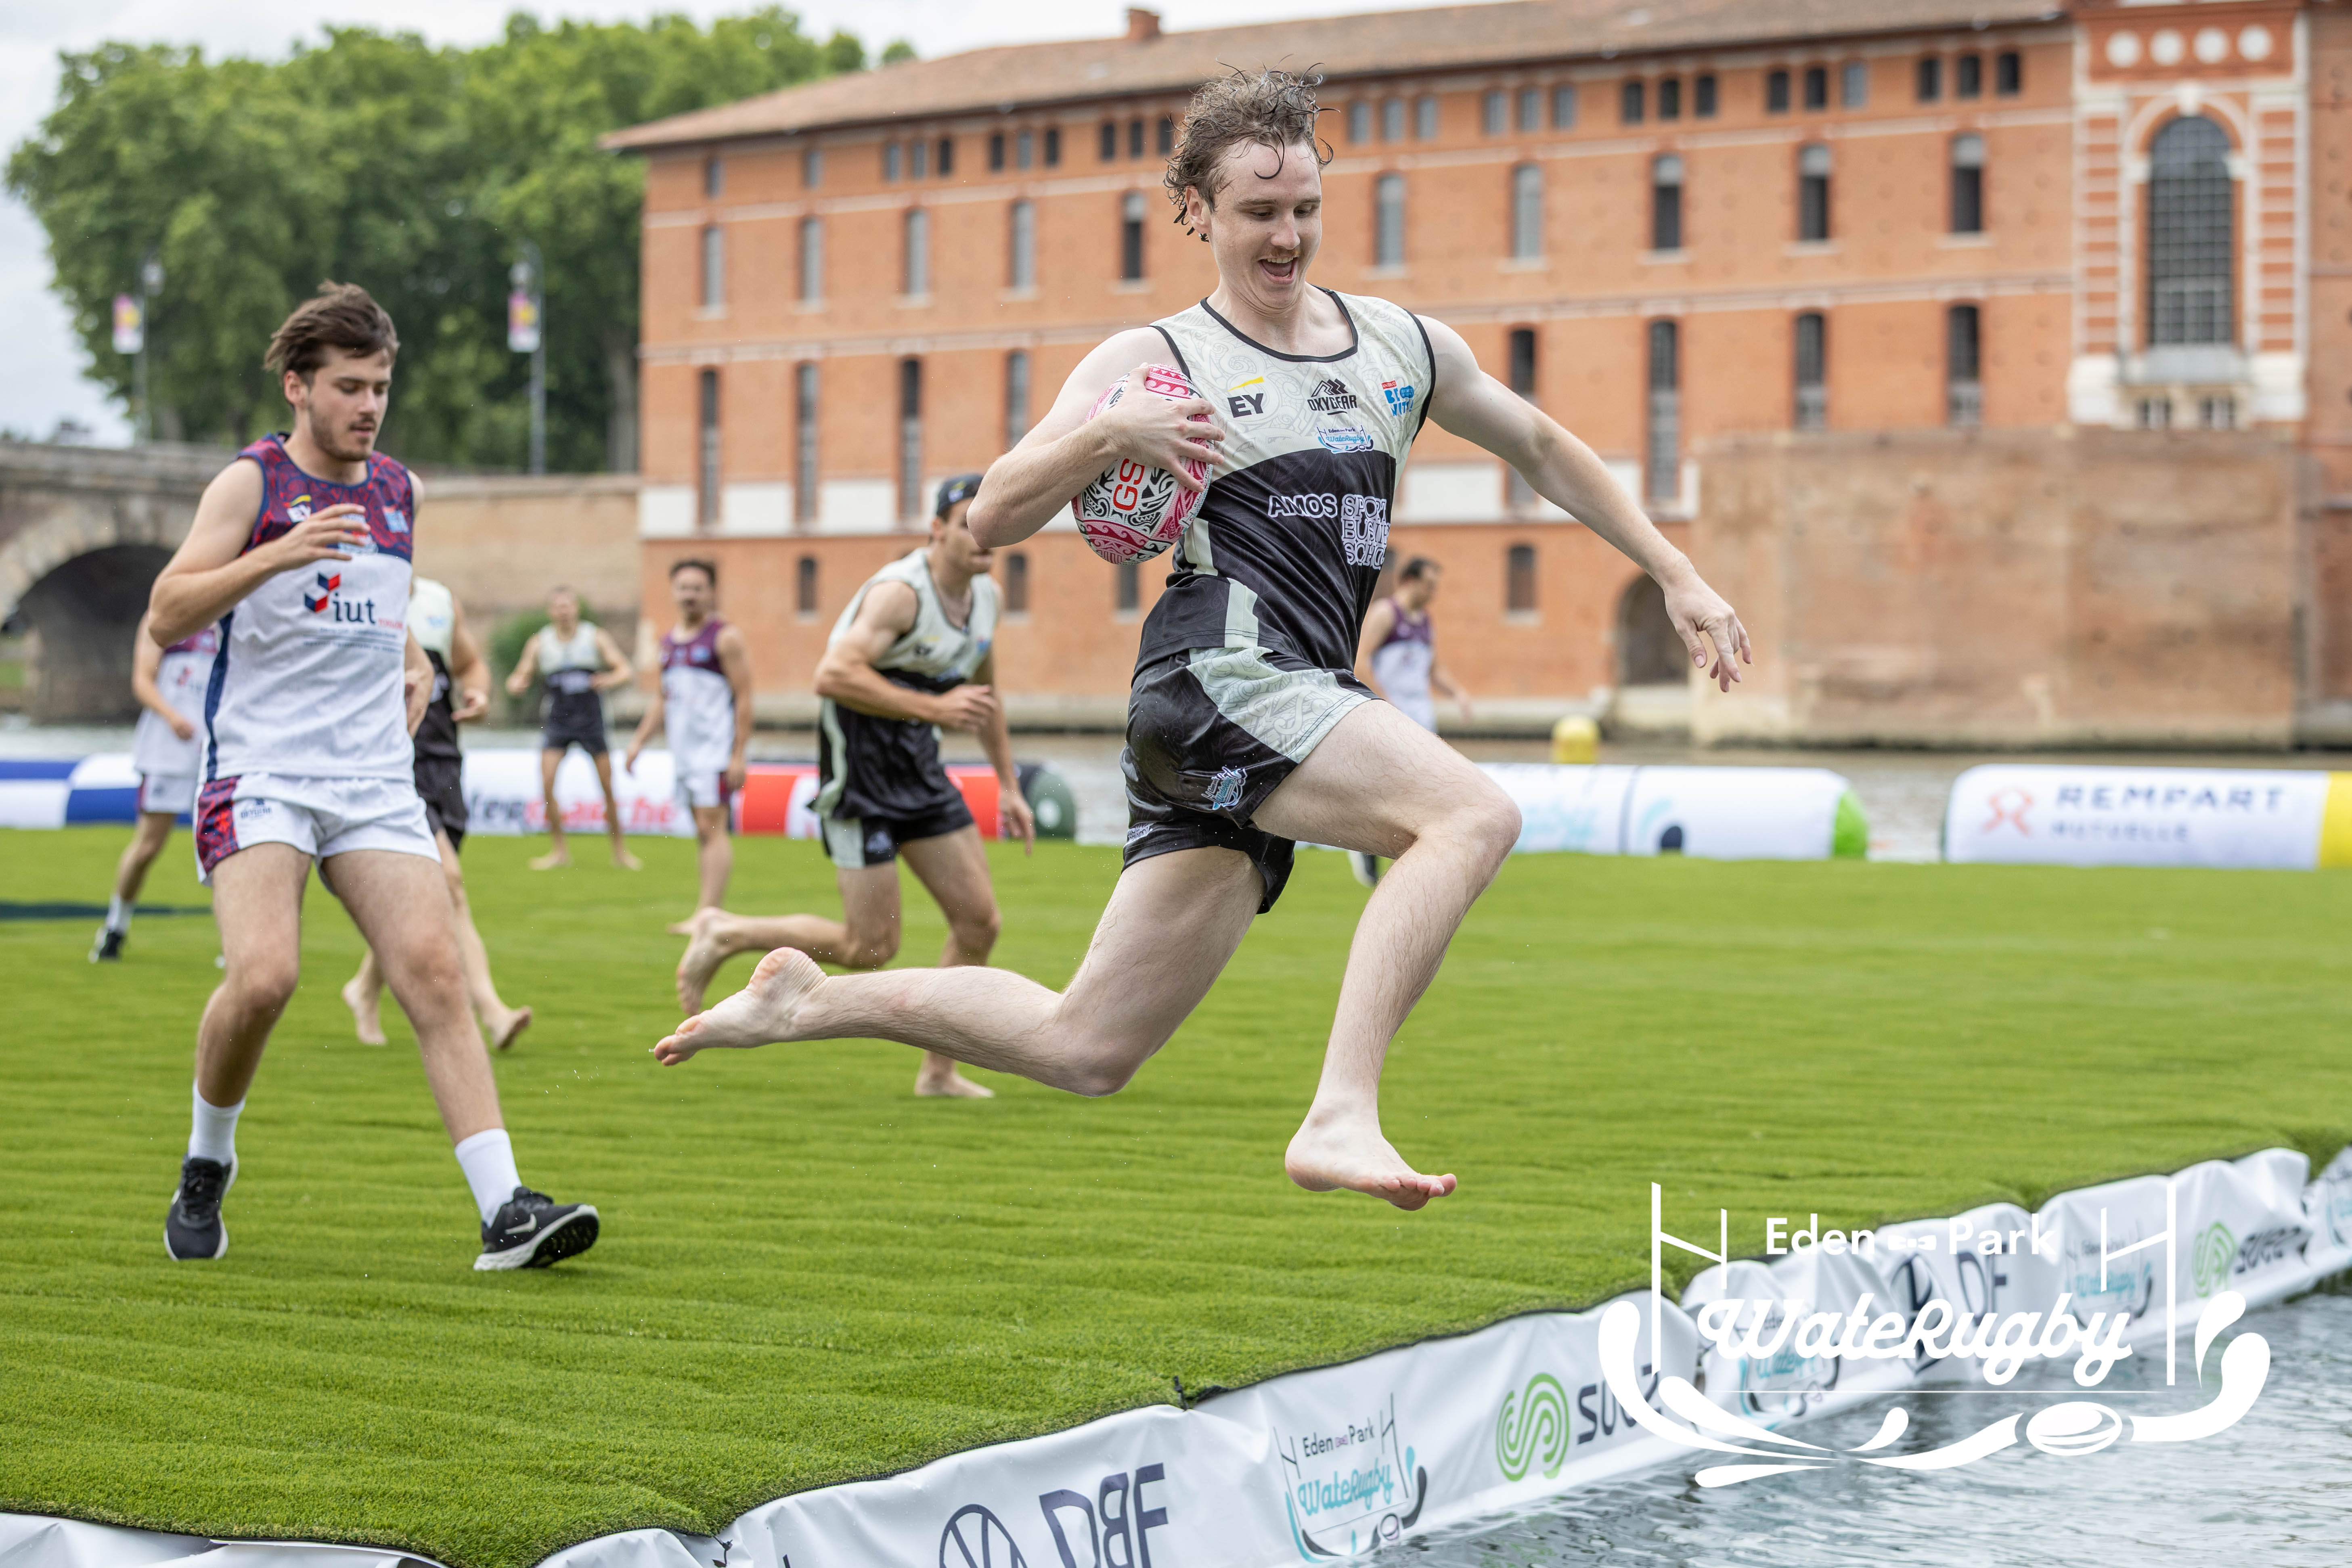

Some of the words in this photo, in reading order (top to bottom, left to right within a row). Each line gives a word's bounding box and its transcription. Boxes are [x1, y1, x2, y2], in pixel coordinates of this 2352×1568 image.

[1227, 393, 1264, 418] EY
[1307, 395, 1358, 412] OXYGEAR
[1326, 434, 1365, 444] WateRugby
[1268, 493, 1338, 518] AMOS
[332, 592, 376, 624] iut
[2056, 785, 2286, 812] REMPART
[2051, 821, 2189, 842] MUTUELLE
[1303, 1432, 1334, 1457] Eden
[1348, 1416, 1376, 1445] Park
[1298, 1457, 1394, 1516] WateRugby
